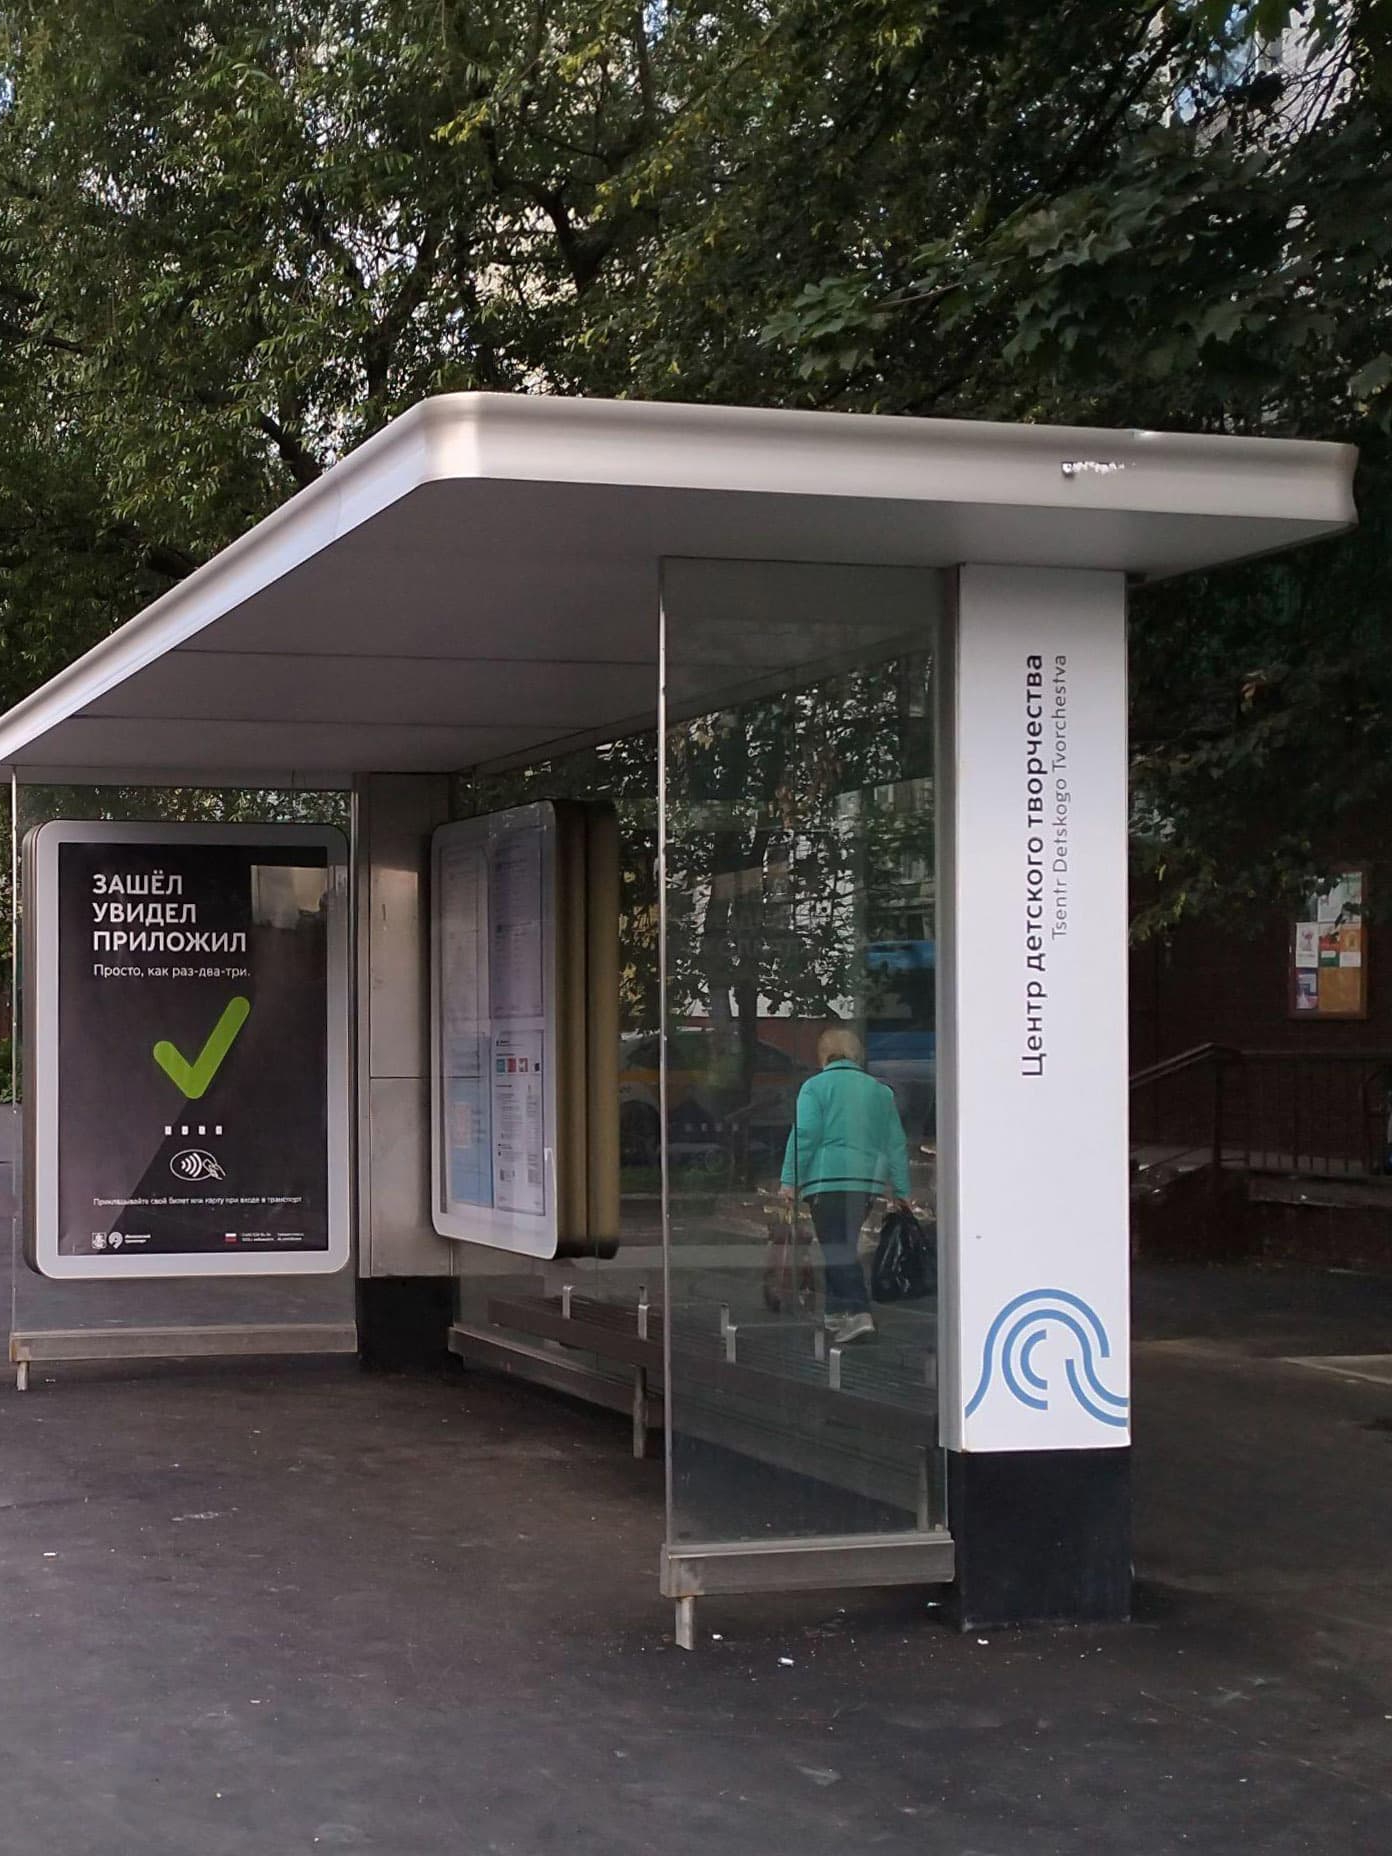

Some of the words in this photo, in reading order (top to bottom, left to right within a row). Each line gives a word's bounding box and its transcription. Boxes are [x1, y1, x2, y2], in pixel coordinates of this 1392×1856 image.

[1026, 655, 1048, 828] творчества
[1051, 655, 1067, 772] Tvorchestva
[1052, 778, 1071, 872] Detskogo
[92, 869, 183, 895] ЗАШЁЛ
[92, 902, 197, 927] УВИДЕЛ
[1026, 837, 1046, 972] детского
[1051, 879, 1067, 940] Tsentr
[93, 931, 247, 952] ПРИЛОЖИЛ
[93, 963, 145, 978] Просто,
[147, 967, 169, 977] как
[172, 966, 251, 979] раз-два-три.
[1022, 981, 1047, 1076] Центр
